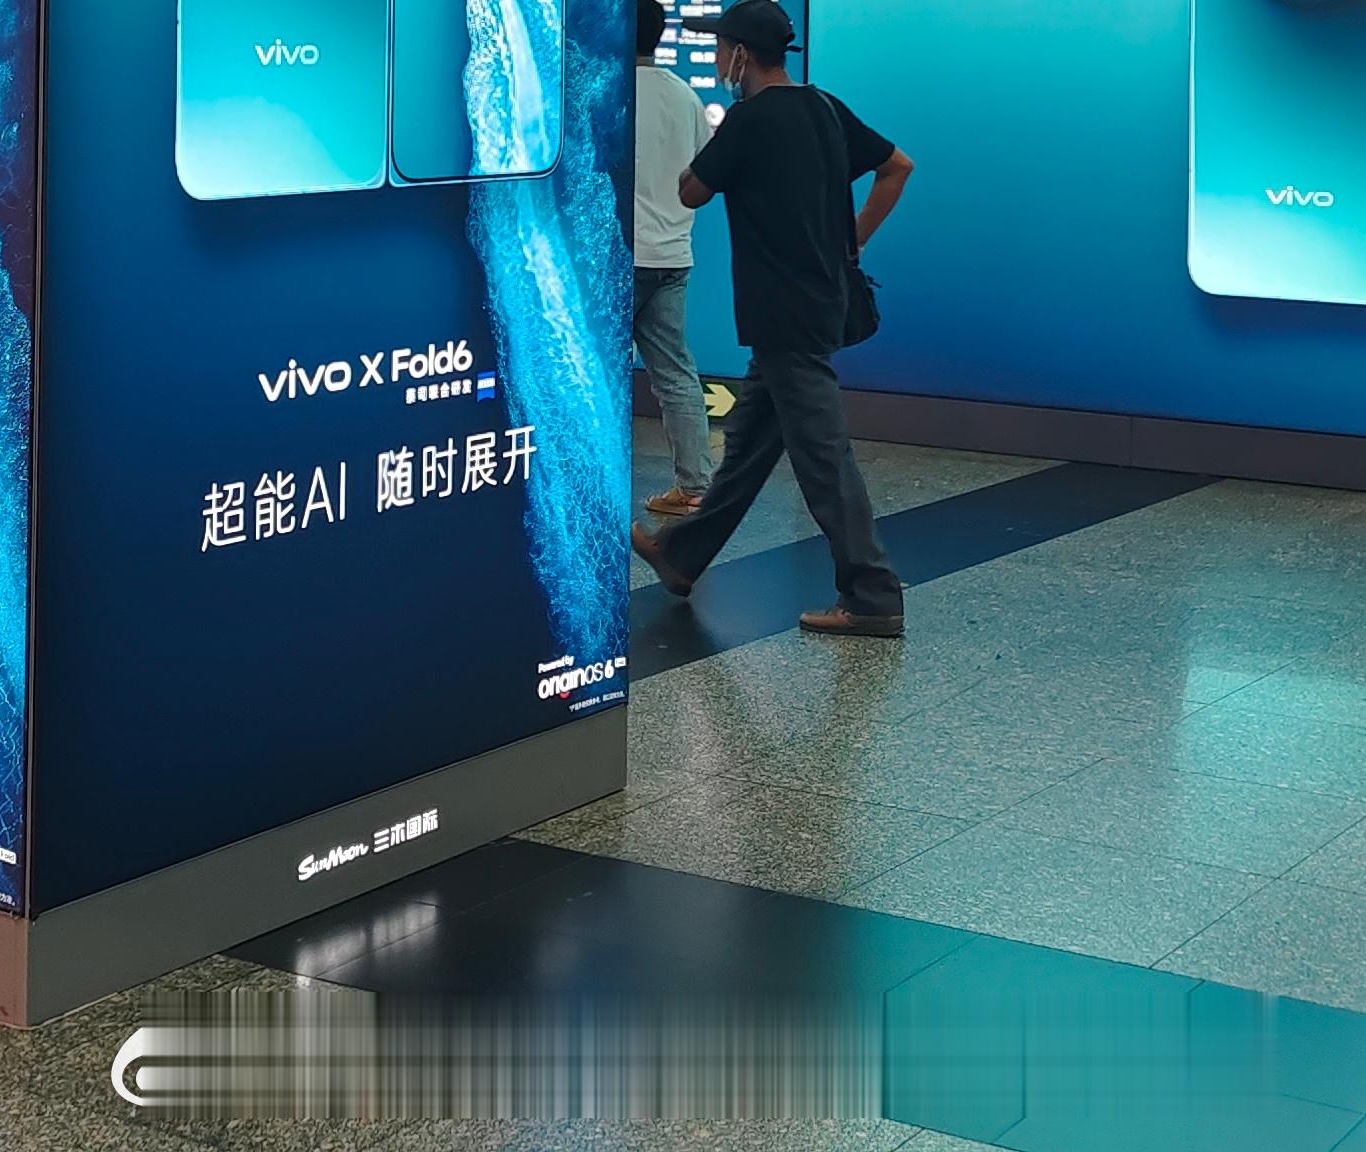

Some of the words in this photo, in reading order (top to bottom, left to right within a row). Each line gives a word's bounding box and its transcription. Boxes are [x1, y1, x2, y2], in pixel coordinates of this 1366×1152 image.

[255, 38, 320, 66] vivo
[1265, 185, 1335, 207] vivo
[258, 359, 352, 402] vivo
[359, 352, 384, 387] X
[391, 340, 473, 384] Fold6
[201, 461, 346, 552] 超能AI
[377, 425, 537, 513] 随时展开
[373, 808, 439, 853] 三木国际
